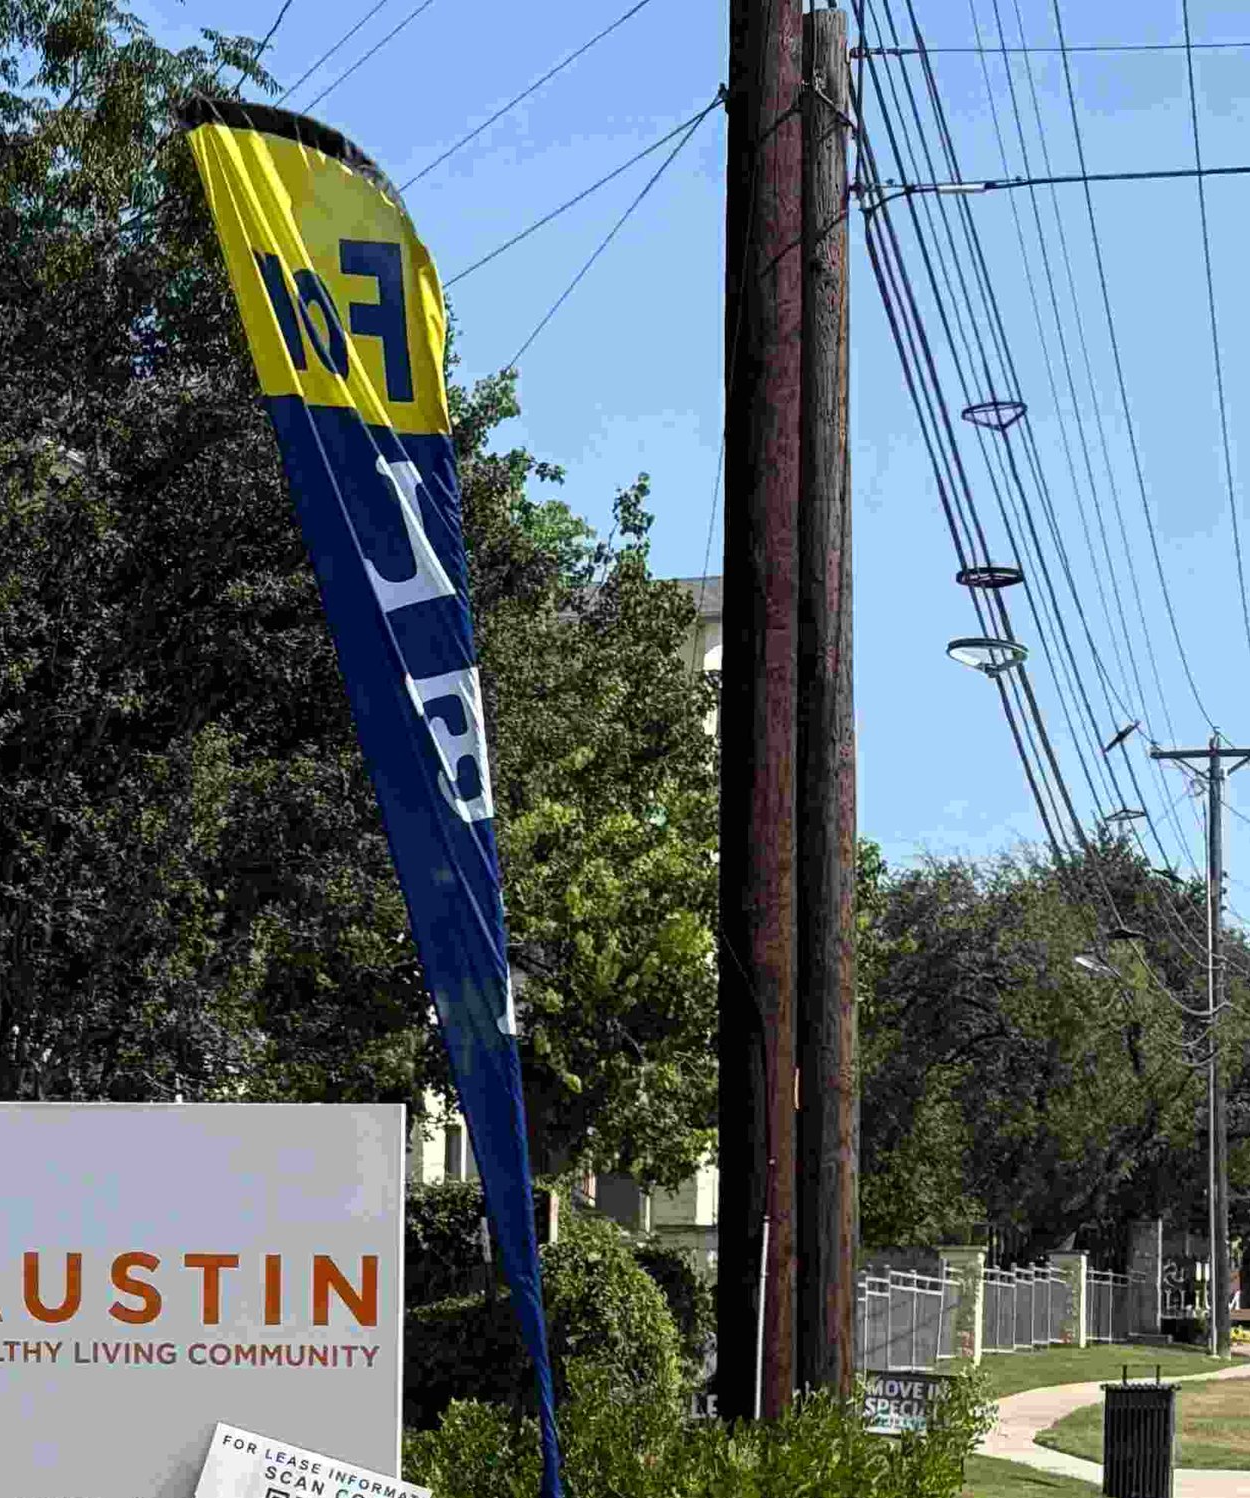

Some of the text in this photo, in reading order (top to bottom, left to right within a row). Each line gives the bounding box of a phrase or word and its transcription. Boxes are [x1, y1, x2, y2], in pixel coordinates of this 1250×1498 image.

[74, 1342, 177, 1365] LIVING
[188, 1343, 381, 1368] COMMUNITY
[864, 1378, 924, 1400] MOVE
[222, 1435, 258, 1455] FOR
[264, 1448, 323, 1475] LEASE
[264, 1466, 326, 1496] SCAN
